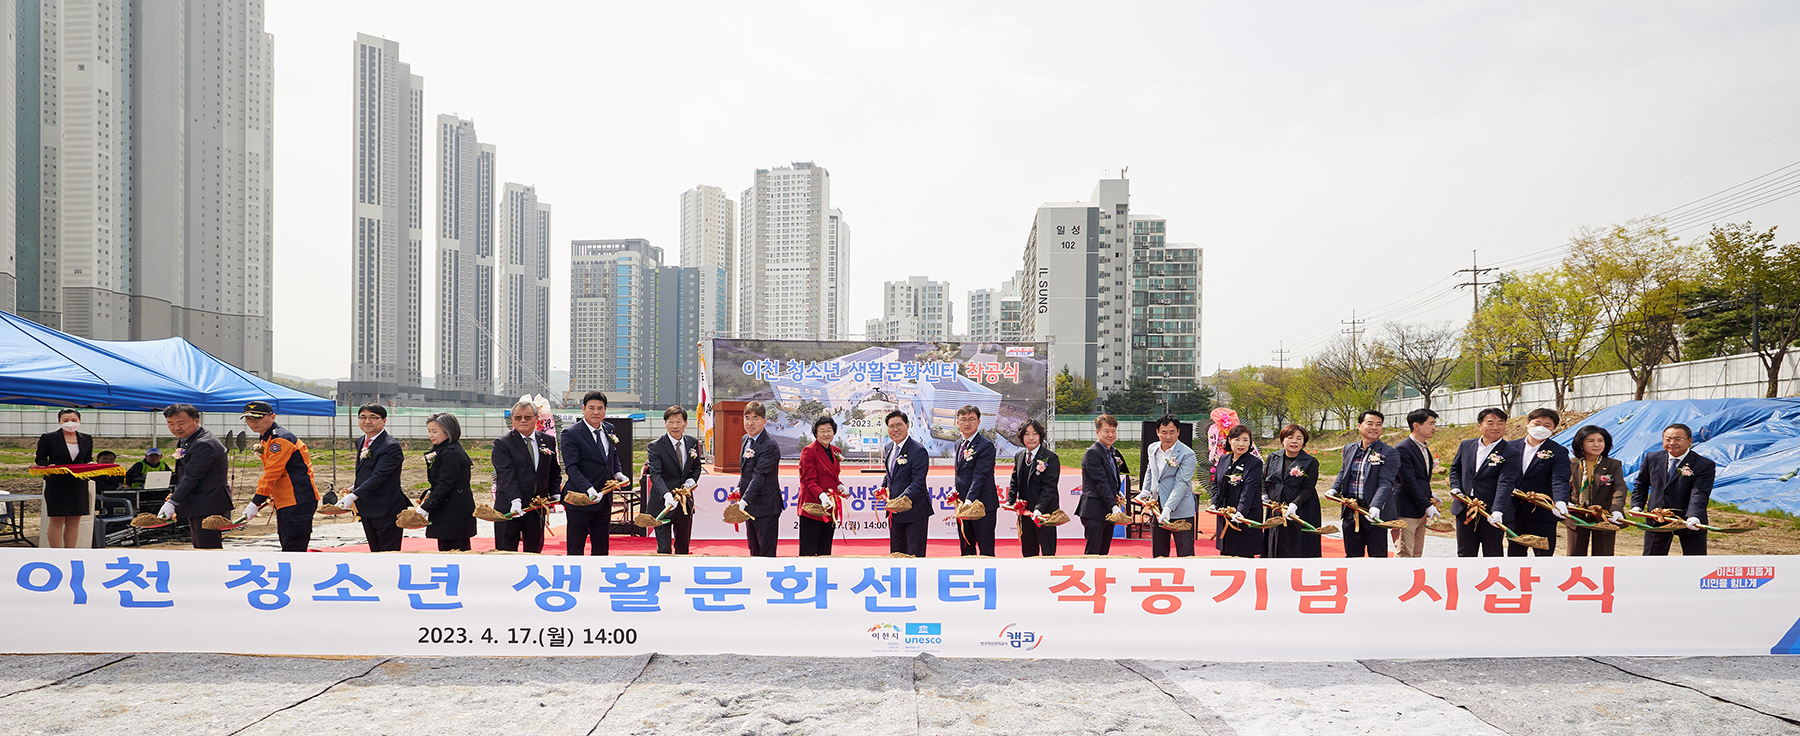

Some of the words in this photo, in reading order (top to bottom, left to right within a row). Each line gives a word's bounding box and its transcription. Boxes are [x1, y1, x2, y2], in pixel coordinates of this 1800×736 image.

[1060, 241, 1076, 249] 102
[743, 360, 779, 381] 이천
[787, 360, 840, 382] 청소년
[849, 361, 957, 382] 생활문화센터
[967, 361, 1019, 383] 착공식
[851, 420, 873, 428] 2023.
[864, 521, 888, 530] 14:00
[1717, 567, 1743, 577] 이천을
[1746, 567, 1773, 577] 새롭게
[17, 557, 174, 608] 이천
[225, 558, 463, 611] 청소년
[513, 560, 998, 613] 생활문화센터
[1049, 564, 1349, 615] 착공기념
[1398, 566, 1616, 614] 시삽식
[1701, 578, 1728, 588] 시민을
[1731, 578, 1757, 588] 힘나게
[418, 627, 474, 644] 2023.
[481, 627, 499, 644] 4.
[507, 626, 574, 648] 17.(월)
[583, 628, 637, 645] 14:00
[871, 632, 899, 640] 이천시
[1006, 631, 1036, 648] 캠코
